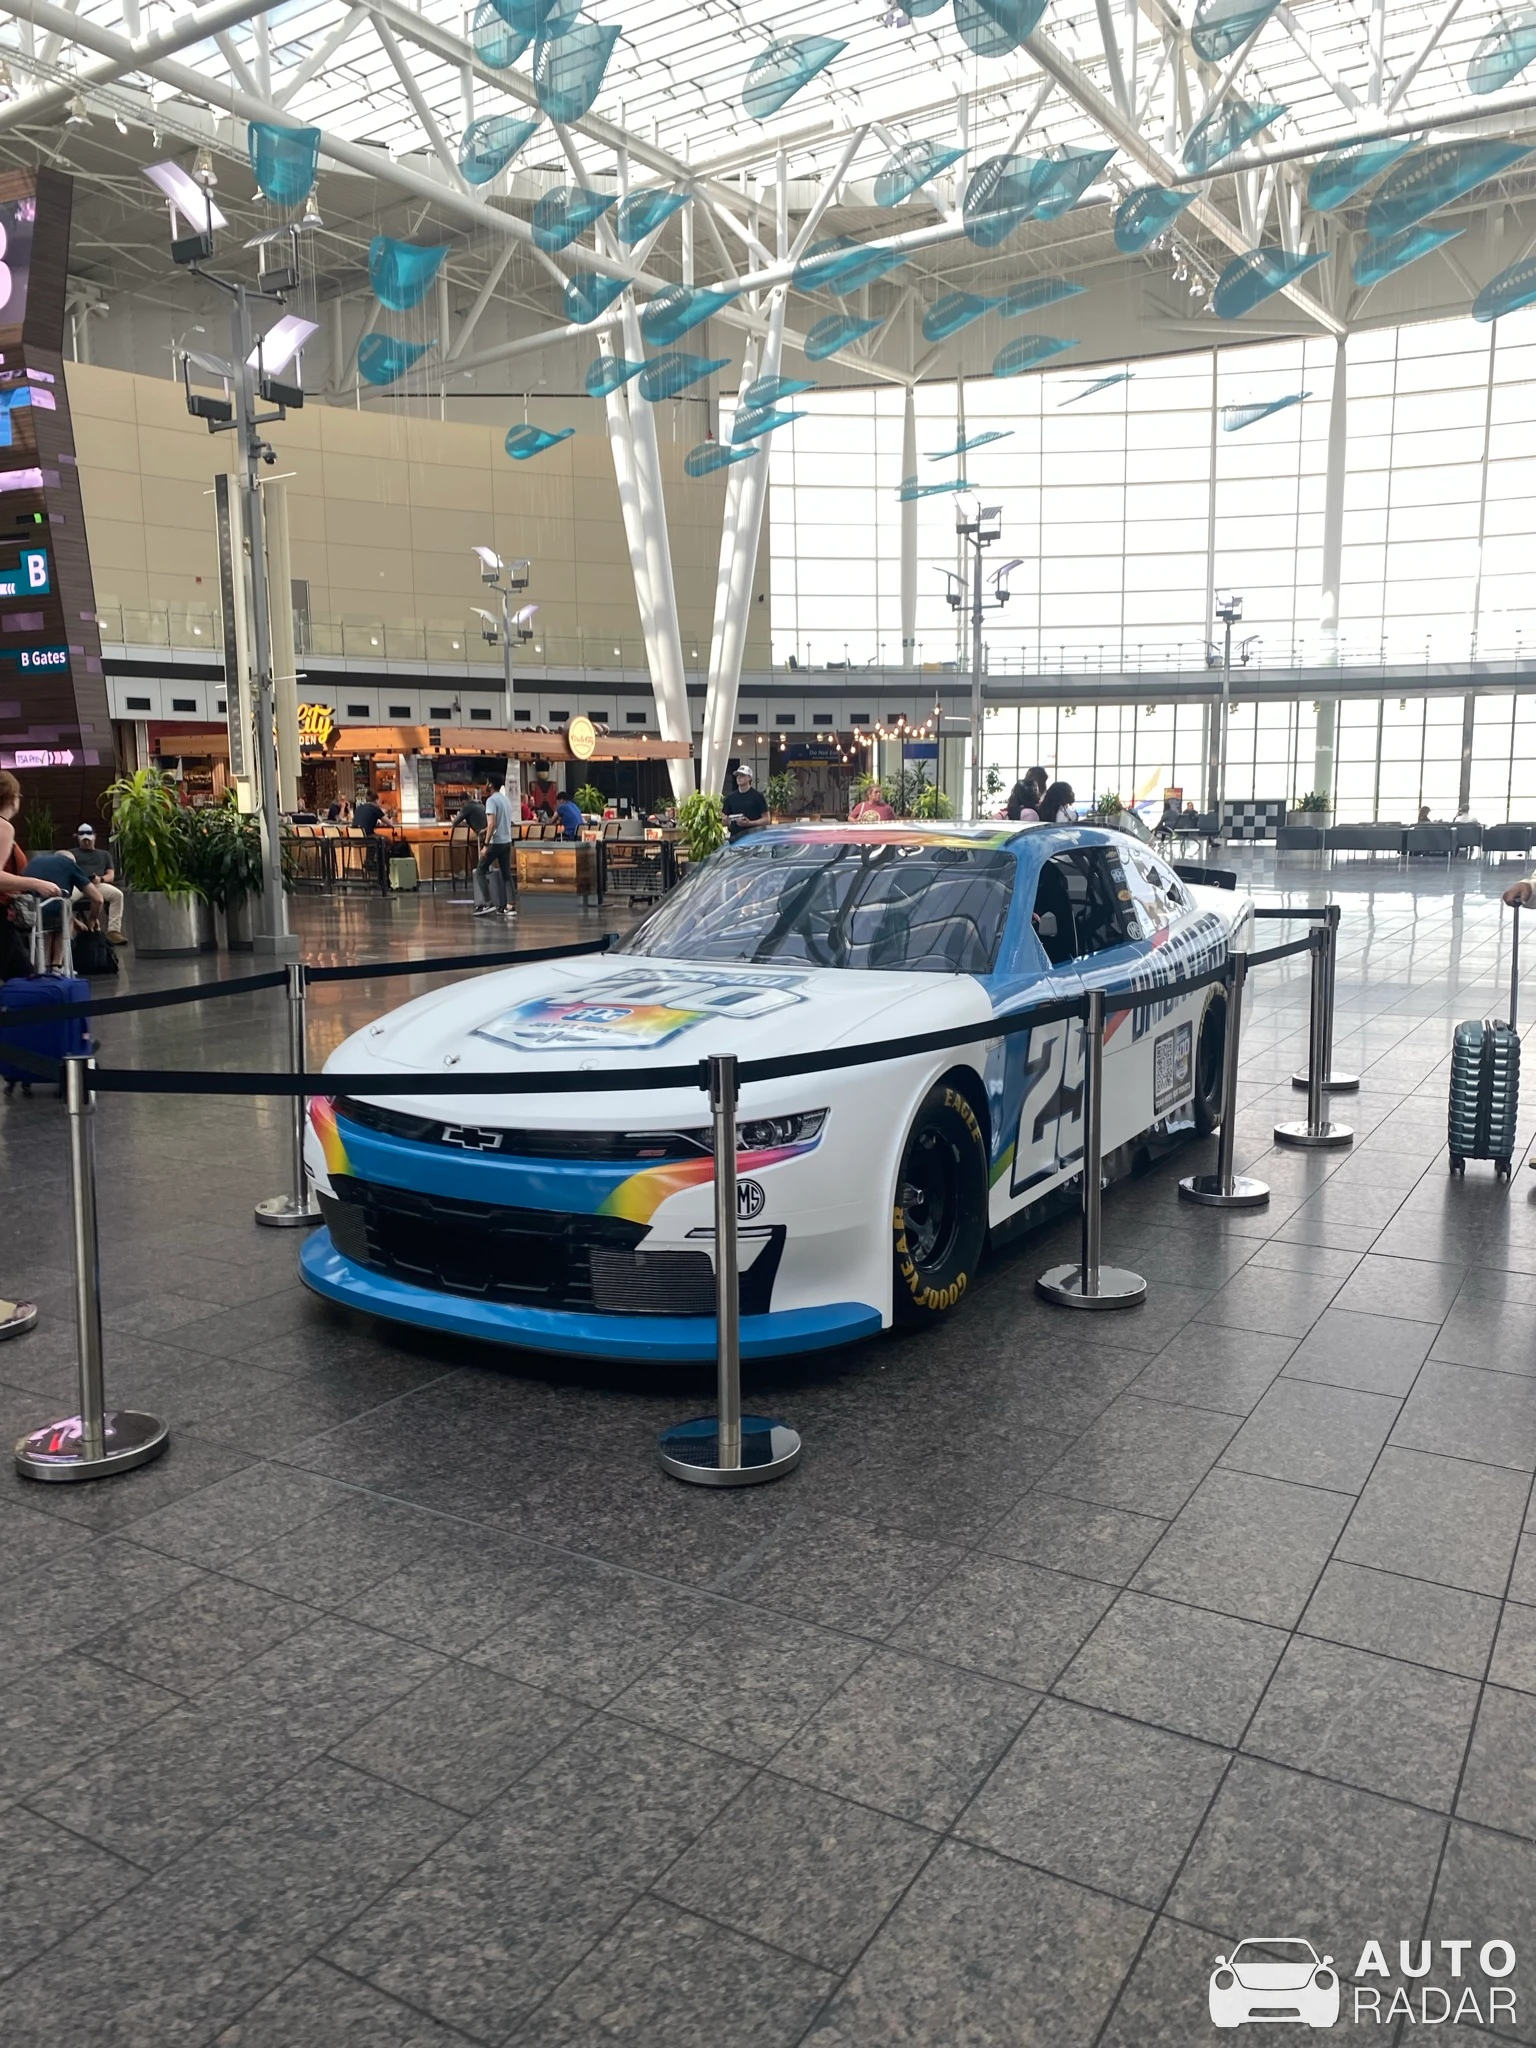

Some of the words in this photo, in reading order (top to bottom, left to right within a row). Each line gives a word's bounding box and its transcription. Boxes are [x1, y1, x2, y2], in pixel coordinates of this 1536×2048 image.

[27, 554, 46, 588] B
[21, 652, 29, 666] B
[32, 651, 66, 666] Gates
[567, 1007, 626, 1021] PPG
[944, 1088, 982, 1143] EAGLE
[737, 1184, 760, 1214] MS
[893, 1206, 968, 1310] GOODYEAR
